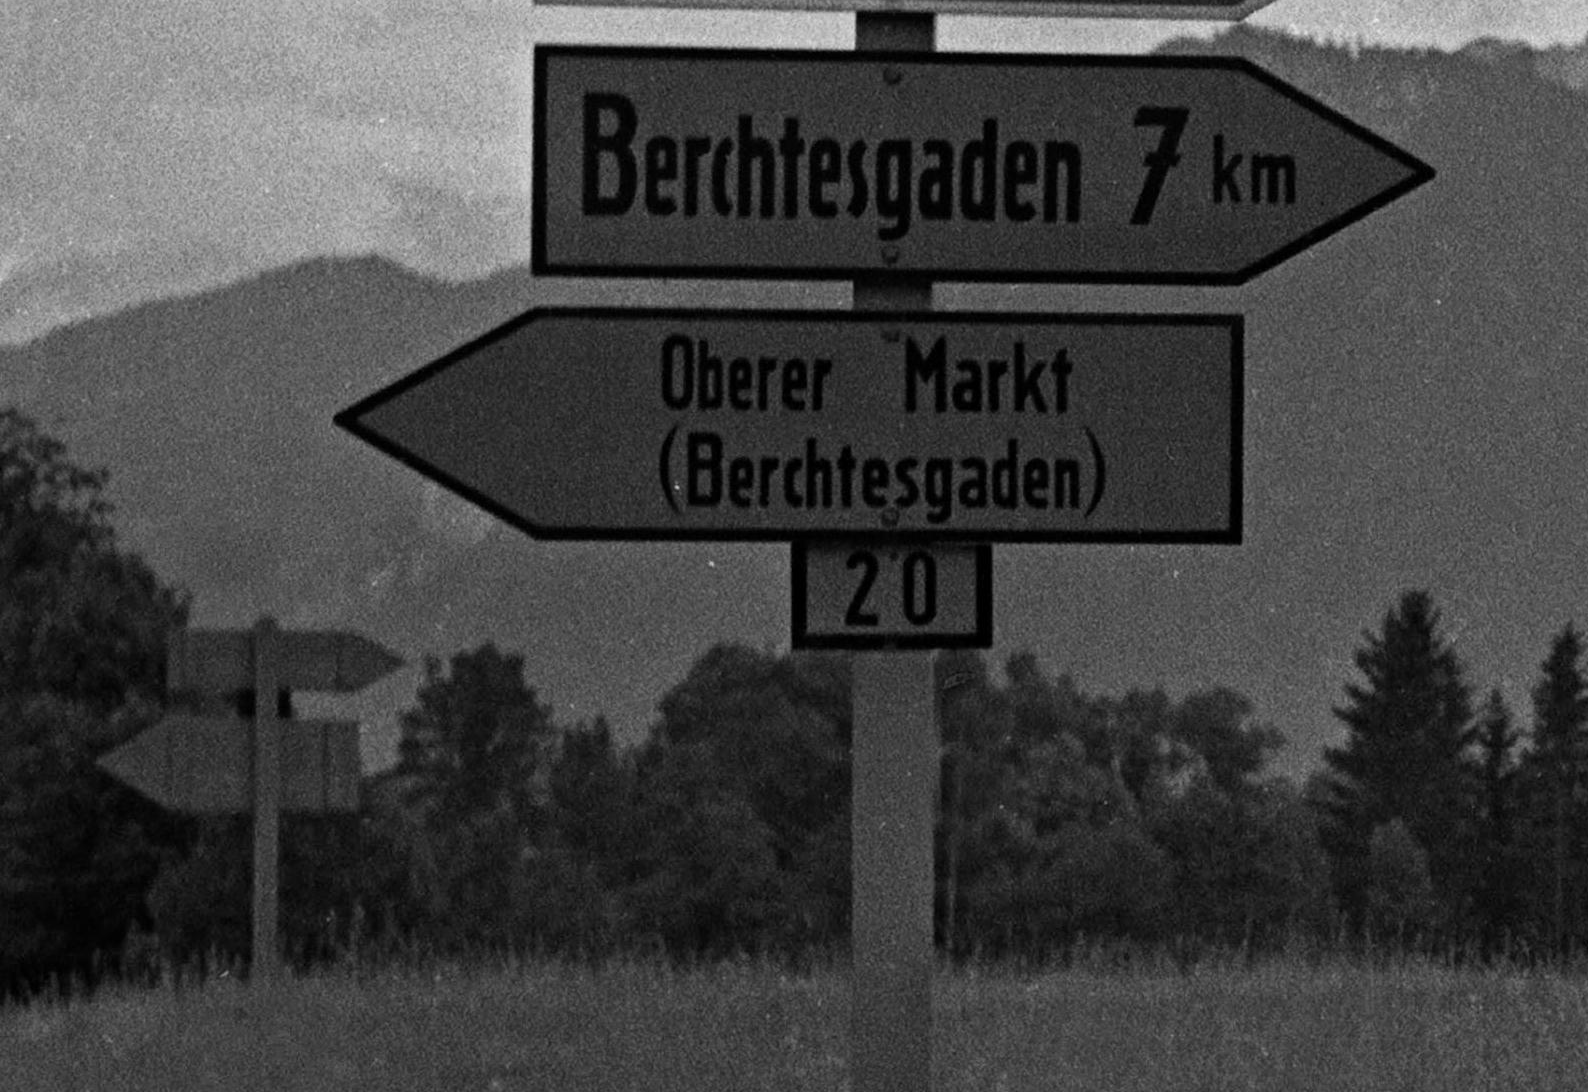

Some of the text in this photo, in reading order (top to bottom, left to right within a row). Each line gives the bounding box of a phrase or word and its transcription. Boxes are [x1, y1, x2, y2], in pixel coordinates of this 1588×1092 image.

[581, 91, 1297, 240] Berchtesgaden 7 km
[660, 333, 1074, 414] Oberer Markt
[658, 427, 1107, 522] (Berchtesgaden)
[844, 551, 938, 628] 20
